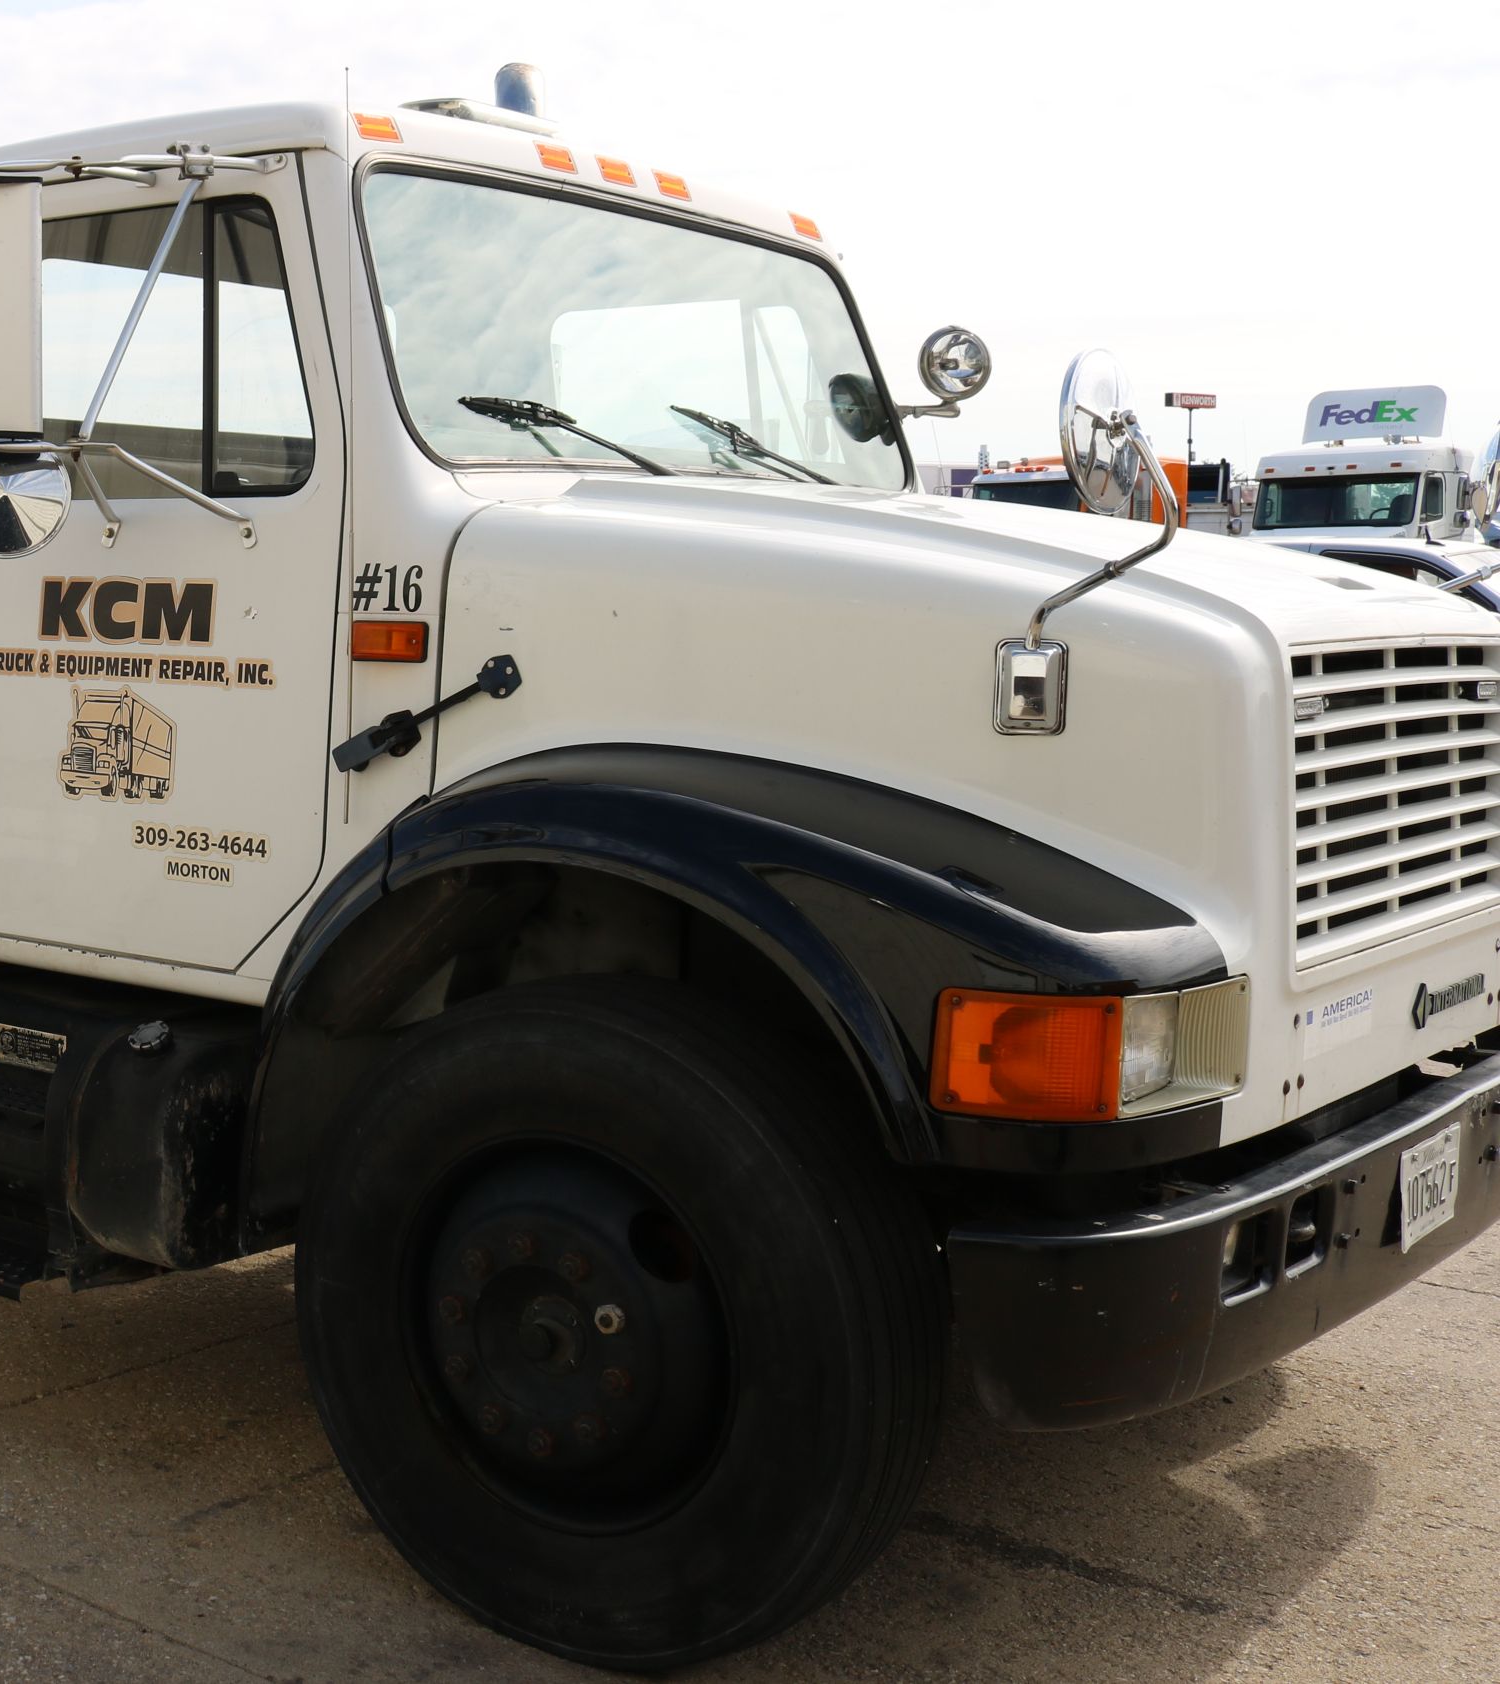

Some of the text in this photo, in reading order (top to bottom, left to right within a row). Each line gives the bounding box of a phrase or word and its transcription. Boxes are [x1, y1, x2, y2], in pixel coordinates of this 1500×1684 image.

[1181, 394, 1216, 407] KENWORTH
[1319, 400, 1419, 427] FedEx
[353, 563, 423, 613] #16
[40, 579, 216, 643] KCM
[39, 653, 50, 673] &
[56, 654, 153, 679] EQUIPMENT
[158, 659, 230, 686] REPAIR,
[237, 663, 273, 685] INC.
[134, 825, 267, 858] 309-263-4644
[167, 861, 230, 882] MORTON
[1322, 989, 1373, 1018] AMERICA!
